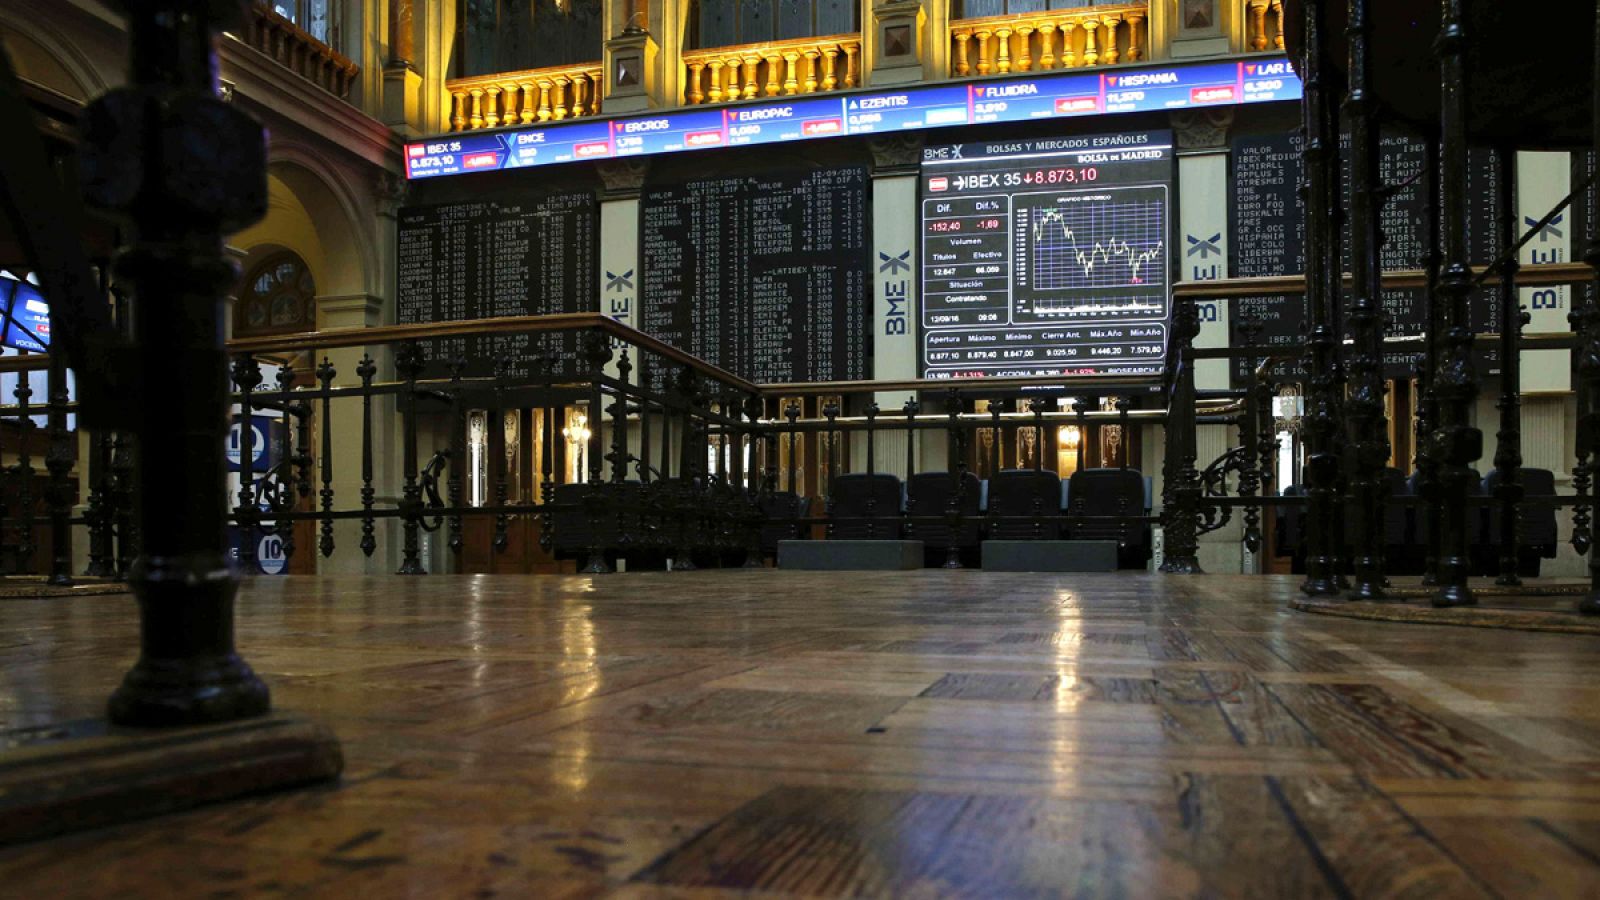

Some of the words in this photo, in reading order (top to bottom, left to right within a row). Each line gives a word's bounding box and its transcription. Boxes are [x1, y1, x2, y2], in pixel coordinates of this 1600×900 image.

[1257, 63, 1284, 75] LAR
[1119, 73, 1178, 86] HISPANIA
[986, 84, 1037, 98] FLUIDRA
[860, 96, 908, 109] EZENTIS
[739, 107, 792, 121] EUROPAC
[625, 120, 670, 133] ERCROS
[518, 133, 544, 144] ENCE
[986, 143, 1023, 154] BOLSAS
[1026, 143, 1033, 152] Y
[1035, 139, 1089, 150] MERCADOS
[1093, 134, 1148, 147] ESPAÑOLES
[428, 144, 449, 153] IBEX
[450, 142, 461, 151] 35
[924, 148, 949, 159] BME
[1078, 154, 1108, 164] BOLSA
[1121, 150, 1162, 161] MADRID
[1237, 162, 1284, 170] ALMIRALL
[965, 174, 1000, 189] IBEX
[1004, 173, 1021, 186] 35
[1035, 168, 1097, 184] 8.873,10
[937, 204, 952, 212] Dif.
[1238, 296, 1285, 305] PROSEGUR
[885, 280, 905, 335] BME
[929, 336, 960, 345] Apertura
[264, 539, 282, 560] 10
